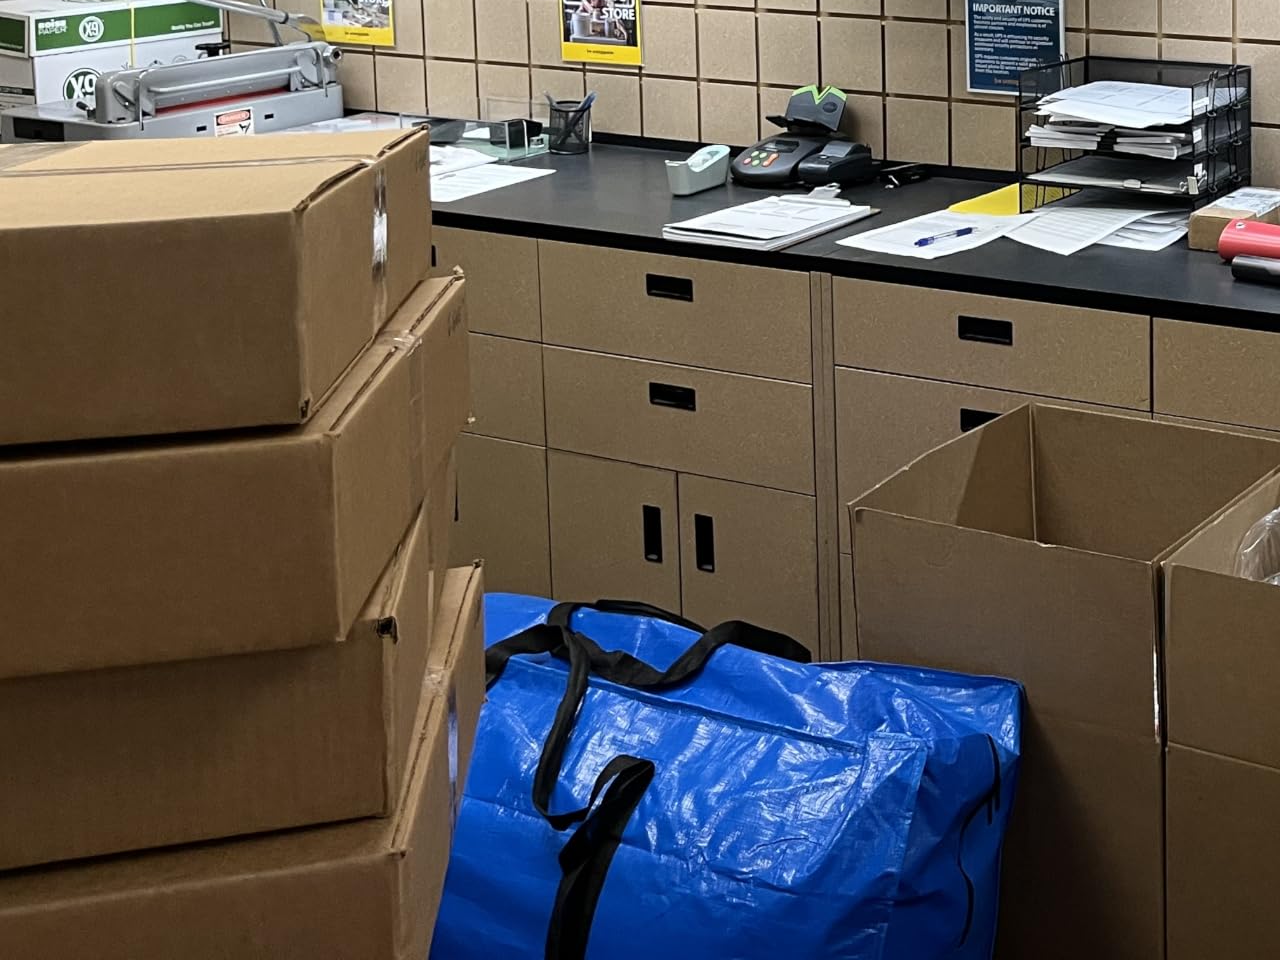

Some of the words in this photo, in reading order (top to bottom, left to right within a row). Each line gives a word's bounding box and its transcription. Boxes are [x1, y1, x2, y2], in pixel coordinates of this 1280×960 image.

[601, 7, 635, 20] STORE
[973, 3, 1023, 15] IMPORTANT
[1023, 6, 1055, 16] NOTICE
